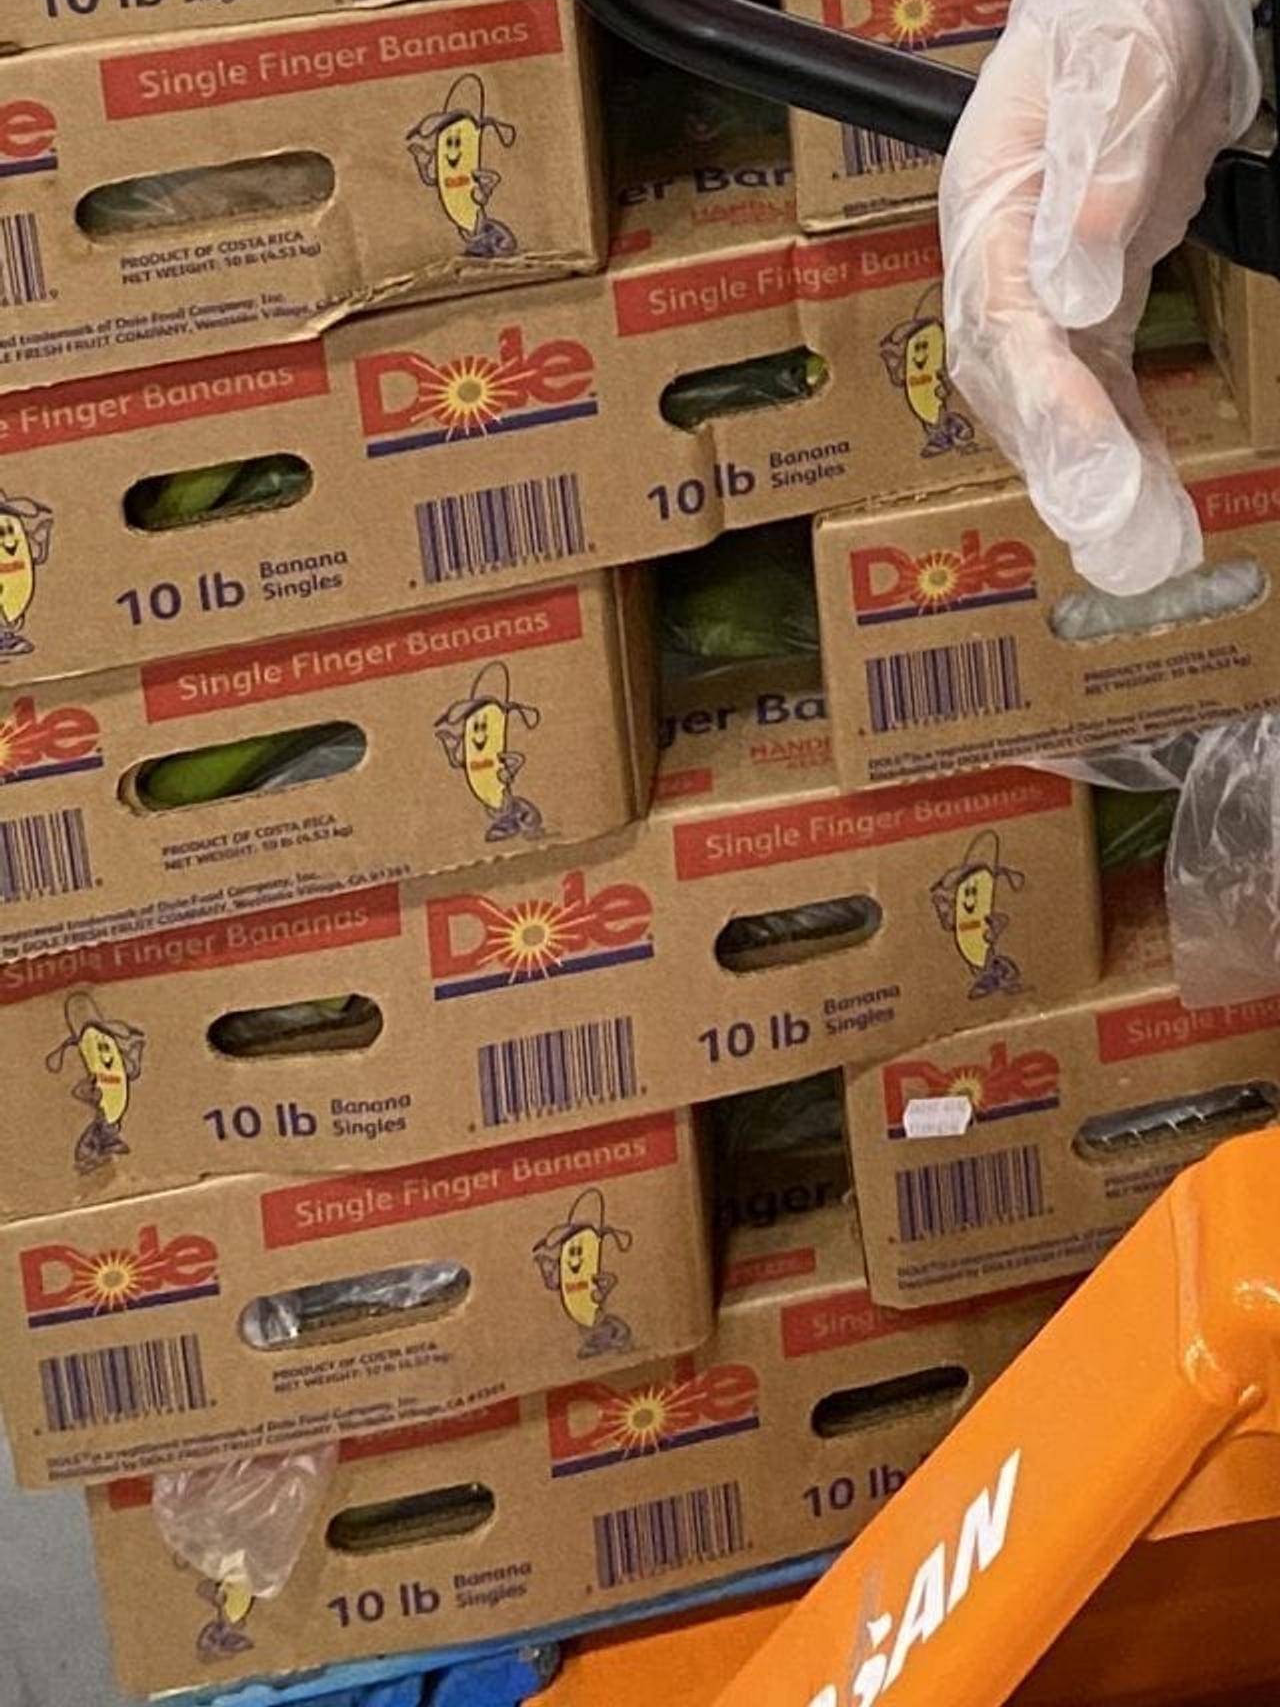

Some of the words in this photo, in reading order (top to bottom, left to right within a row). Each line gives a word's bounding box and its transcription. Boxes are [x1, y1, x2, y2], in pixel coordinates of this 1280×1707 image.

[139, 60, 248, 102] Single
[259, 42, 368, 82] Finger
[377, 17, 530, 62] Bananas
[120, 248, 190, 270] PRODUCT
[649, 276, 748, 315] Single
[20, 394, 142, 436] Finger
[146, 366, 295, 413] Bananas
[354, 325, 595, 438] Dole
[646, 476, 707, 521] 10
[712, 460, 756, 501] lb
[768, 439, 851, 469] Banana
[770, 460, 847, 489] Singles
[115, 586, 183, 627] 10
[199, 573, 246, 612] lb
[259, 548, 348, 580] Banana
[262, 573, 344, 602] Singles
[849, 527, 1038, 611] Dole
[178, 663, 284, 705] Single
[293, 640, 398, 681] Finger
[406, 608, 550, 655] Bananas
[705, 834, 801, 861] Single
[809, 811, 902, 844] Finger
[113, 934, 216, 968] Finger
[226, 907, 369, 948] Bananas
[426, 872, 653, 980] Dole
[699, 1021, 756, 1065] 10
[769, 1012, 810, 1051] lb
[822, 985, 901, 1016] Banana
[824, 1005, 896, 1037] Singles
[201, 1105, 264, 1143] 10
[276, 1102, 318, 1139] lb
[330, 1091, 412, 1116] Banana
[332, 1115, 407, 1138] Singles
[294, 1191, 393, 1229] Single
[401, 1167, 501, 1207] Finger
[511, 1136, 649, 1180] Bananas
[19, 1225, 219, 1315] Dole
[545, 1355, 759, 1462] Dole
[802, 1476, 856, 1519] 10
[326, 1590, 384, 1629] 10
[400, 1583, 441, 1614] lb
[454, 1559, 532, 1589] Banana
[454, 1581, 528, 1609] Singles
